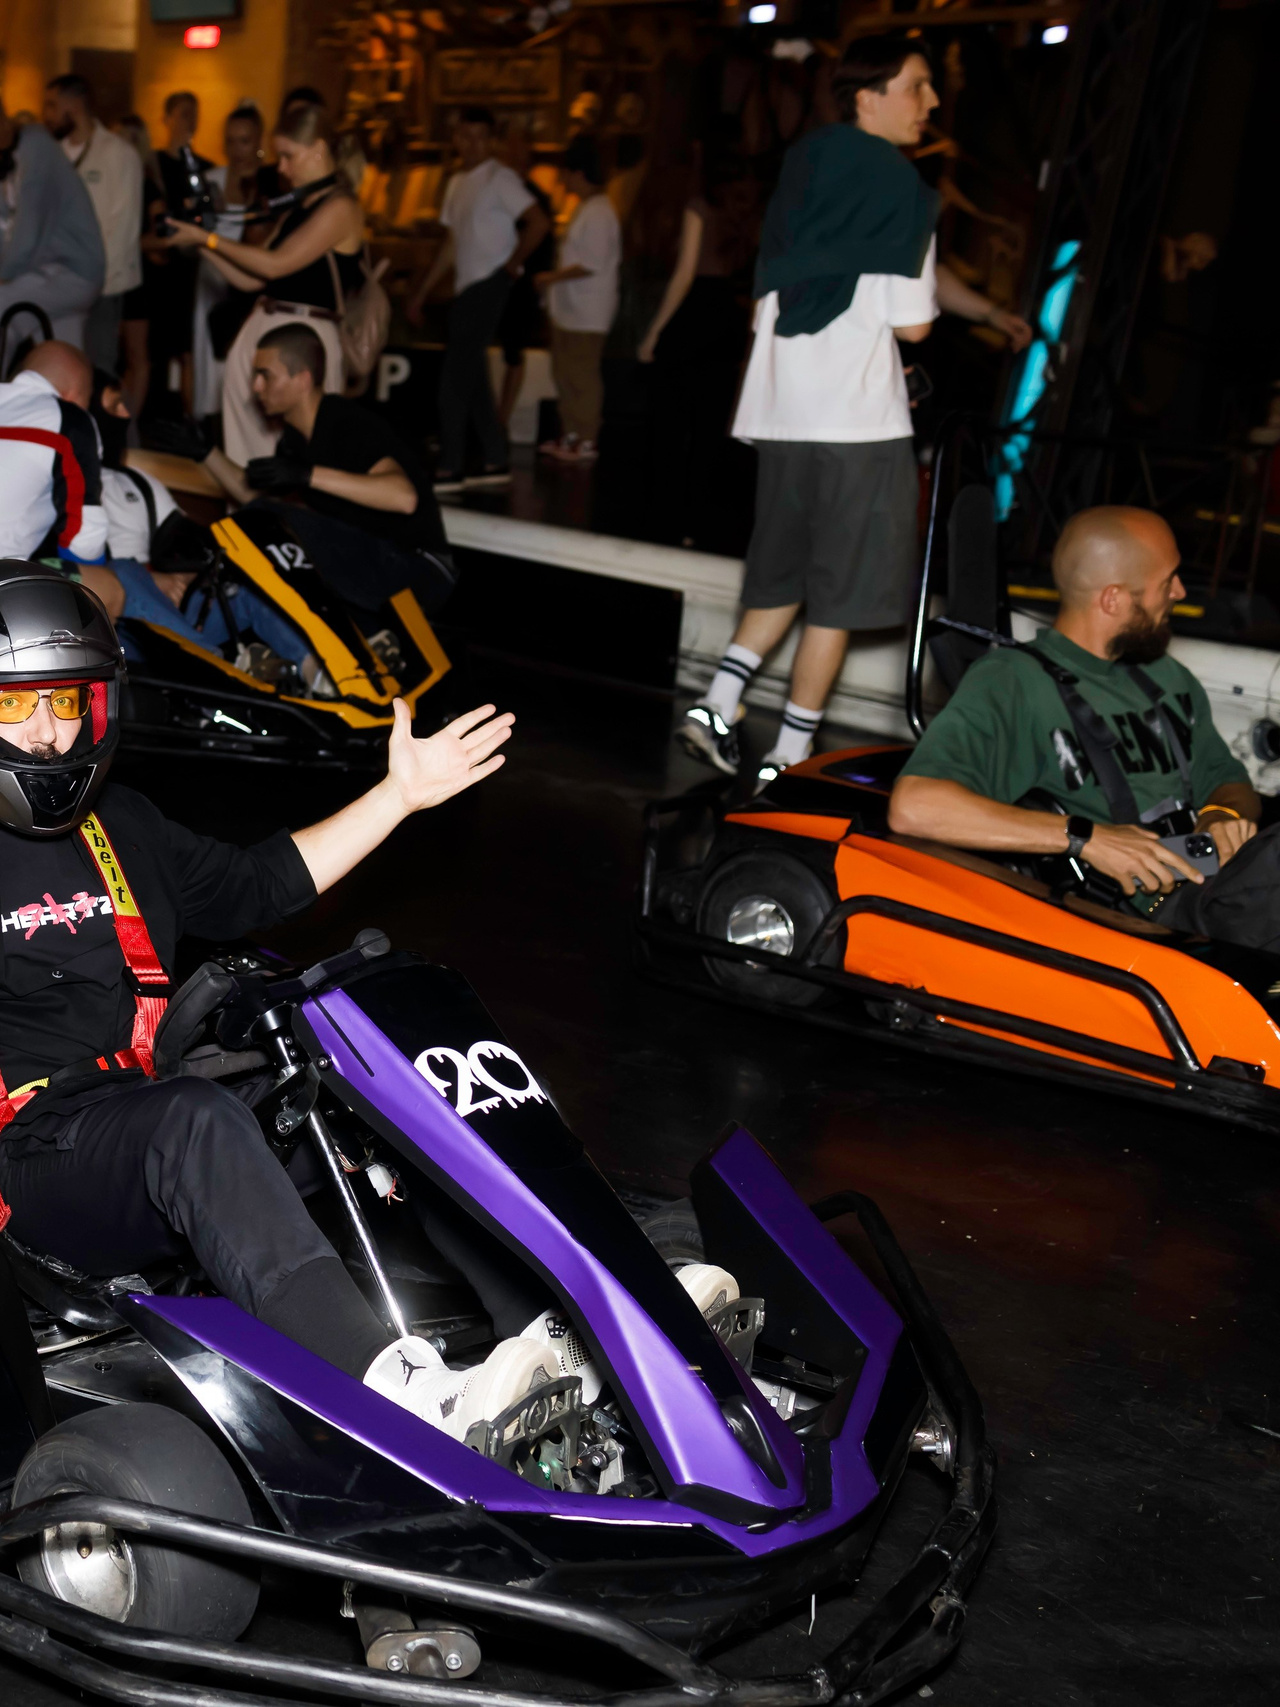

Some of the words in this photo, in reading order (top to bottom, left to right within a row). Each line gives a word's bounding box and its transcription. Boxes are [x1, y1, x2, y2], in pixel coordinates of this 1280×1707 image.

[265, 542, 314, 572] 12
[83, 819, 125, 903] abelt
[414, 1040, 547, 1117] 20
